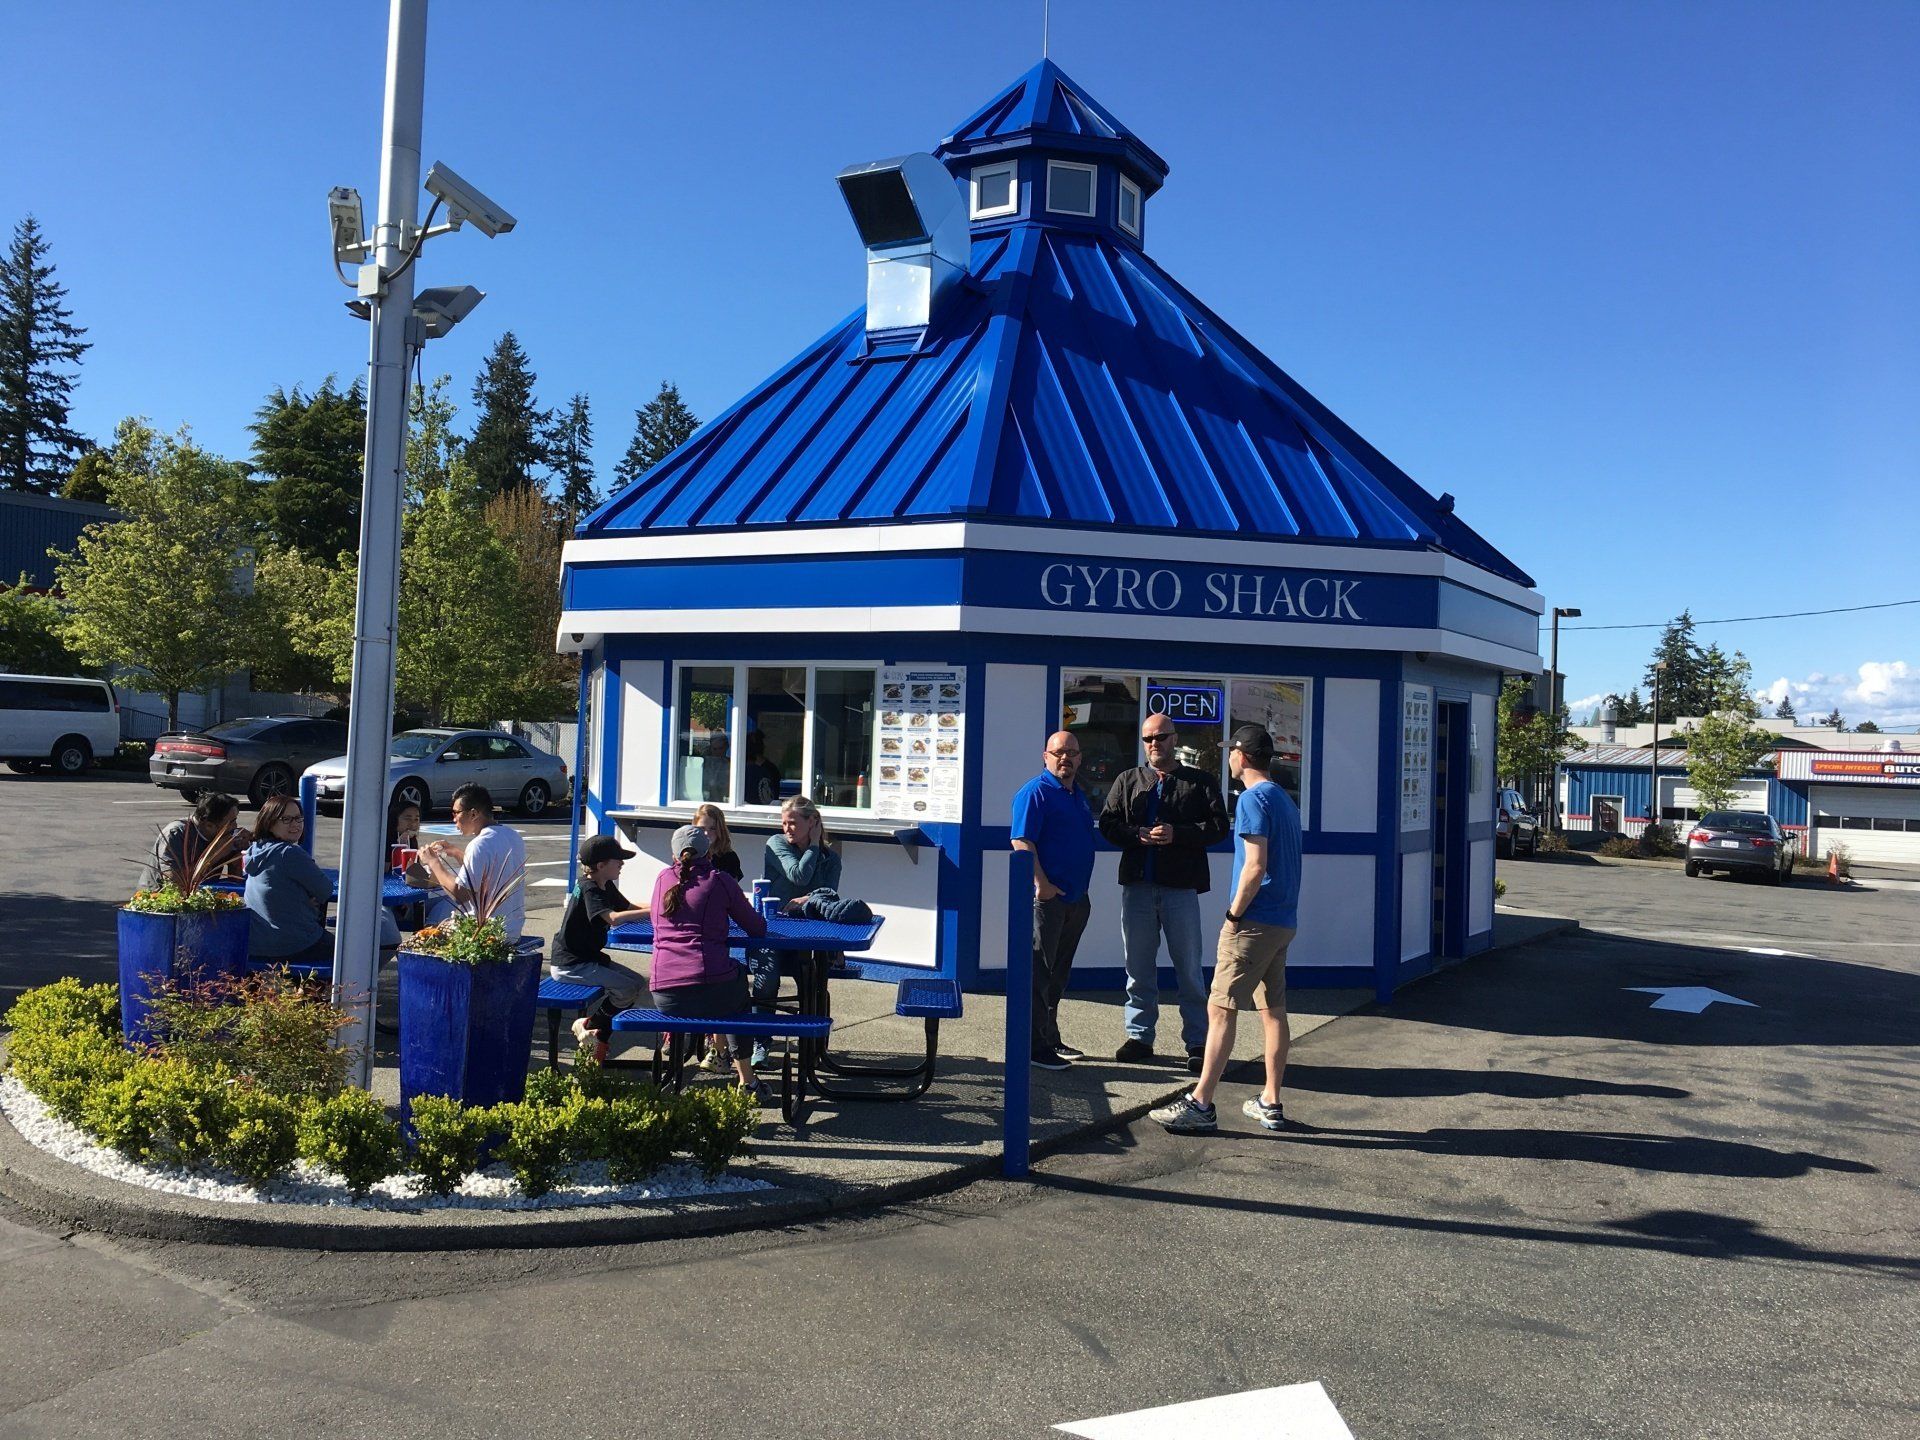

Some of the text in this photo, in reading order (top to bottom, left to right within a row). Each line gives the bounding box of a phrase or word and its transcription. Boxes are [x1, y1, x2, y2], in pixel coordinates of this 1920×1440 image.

[1040, 563, 1364, 620] GYRO SHACK
[1149, 692, 1216, 717] OPEN
